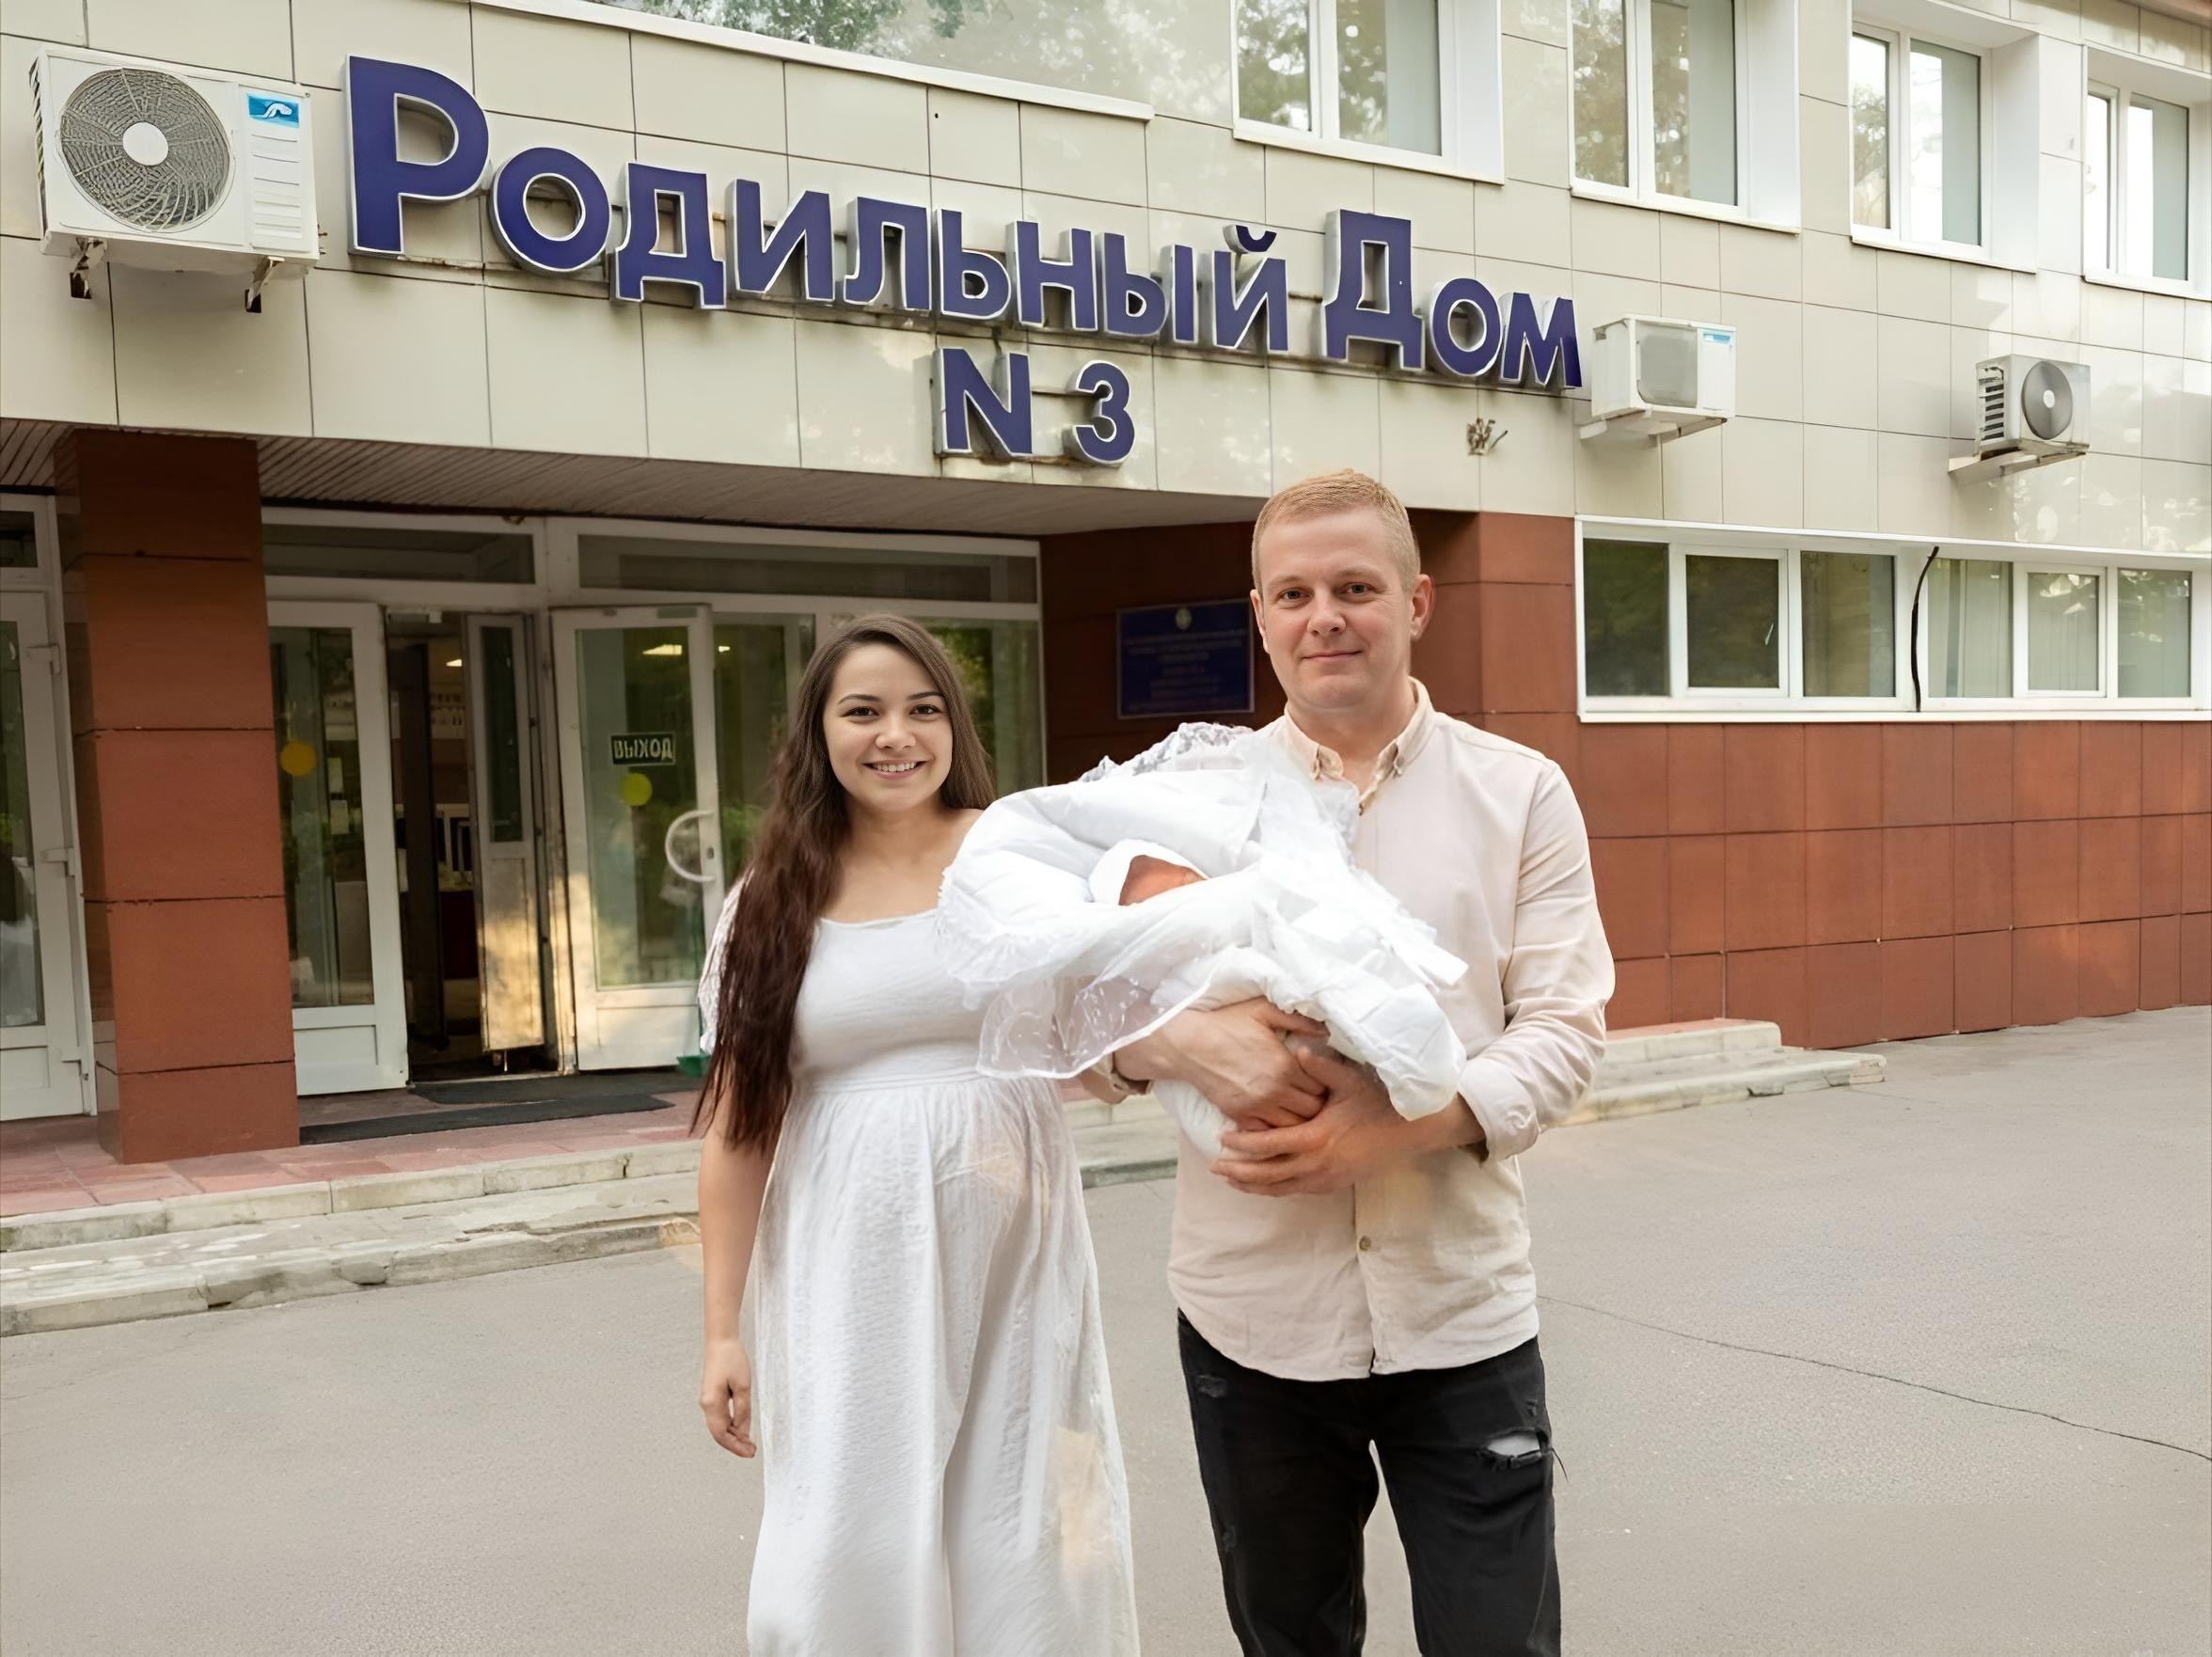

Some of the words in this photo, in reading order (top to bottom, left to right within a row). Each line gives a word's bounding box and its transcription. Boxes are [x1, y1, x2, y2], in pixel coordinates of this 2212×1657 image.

[940, 348, 1034, 458] N
[1072, 360, 1136, 465] 3
[613, 737, 674, 761] ВЫХОД
